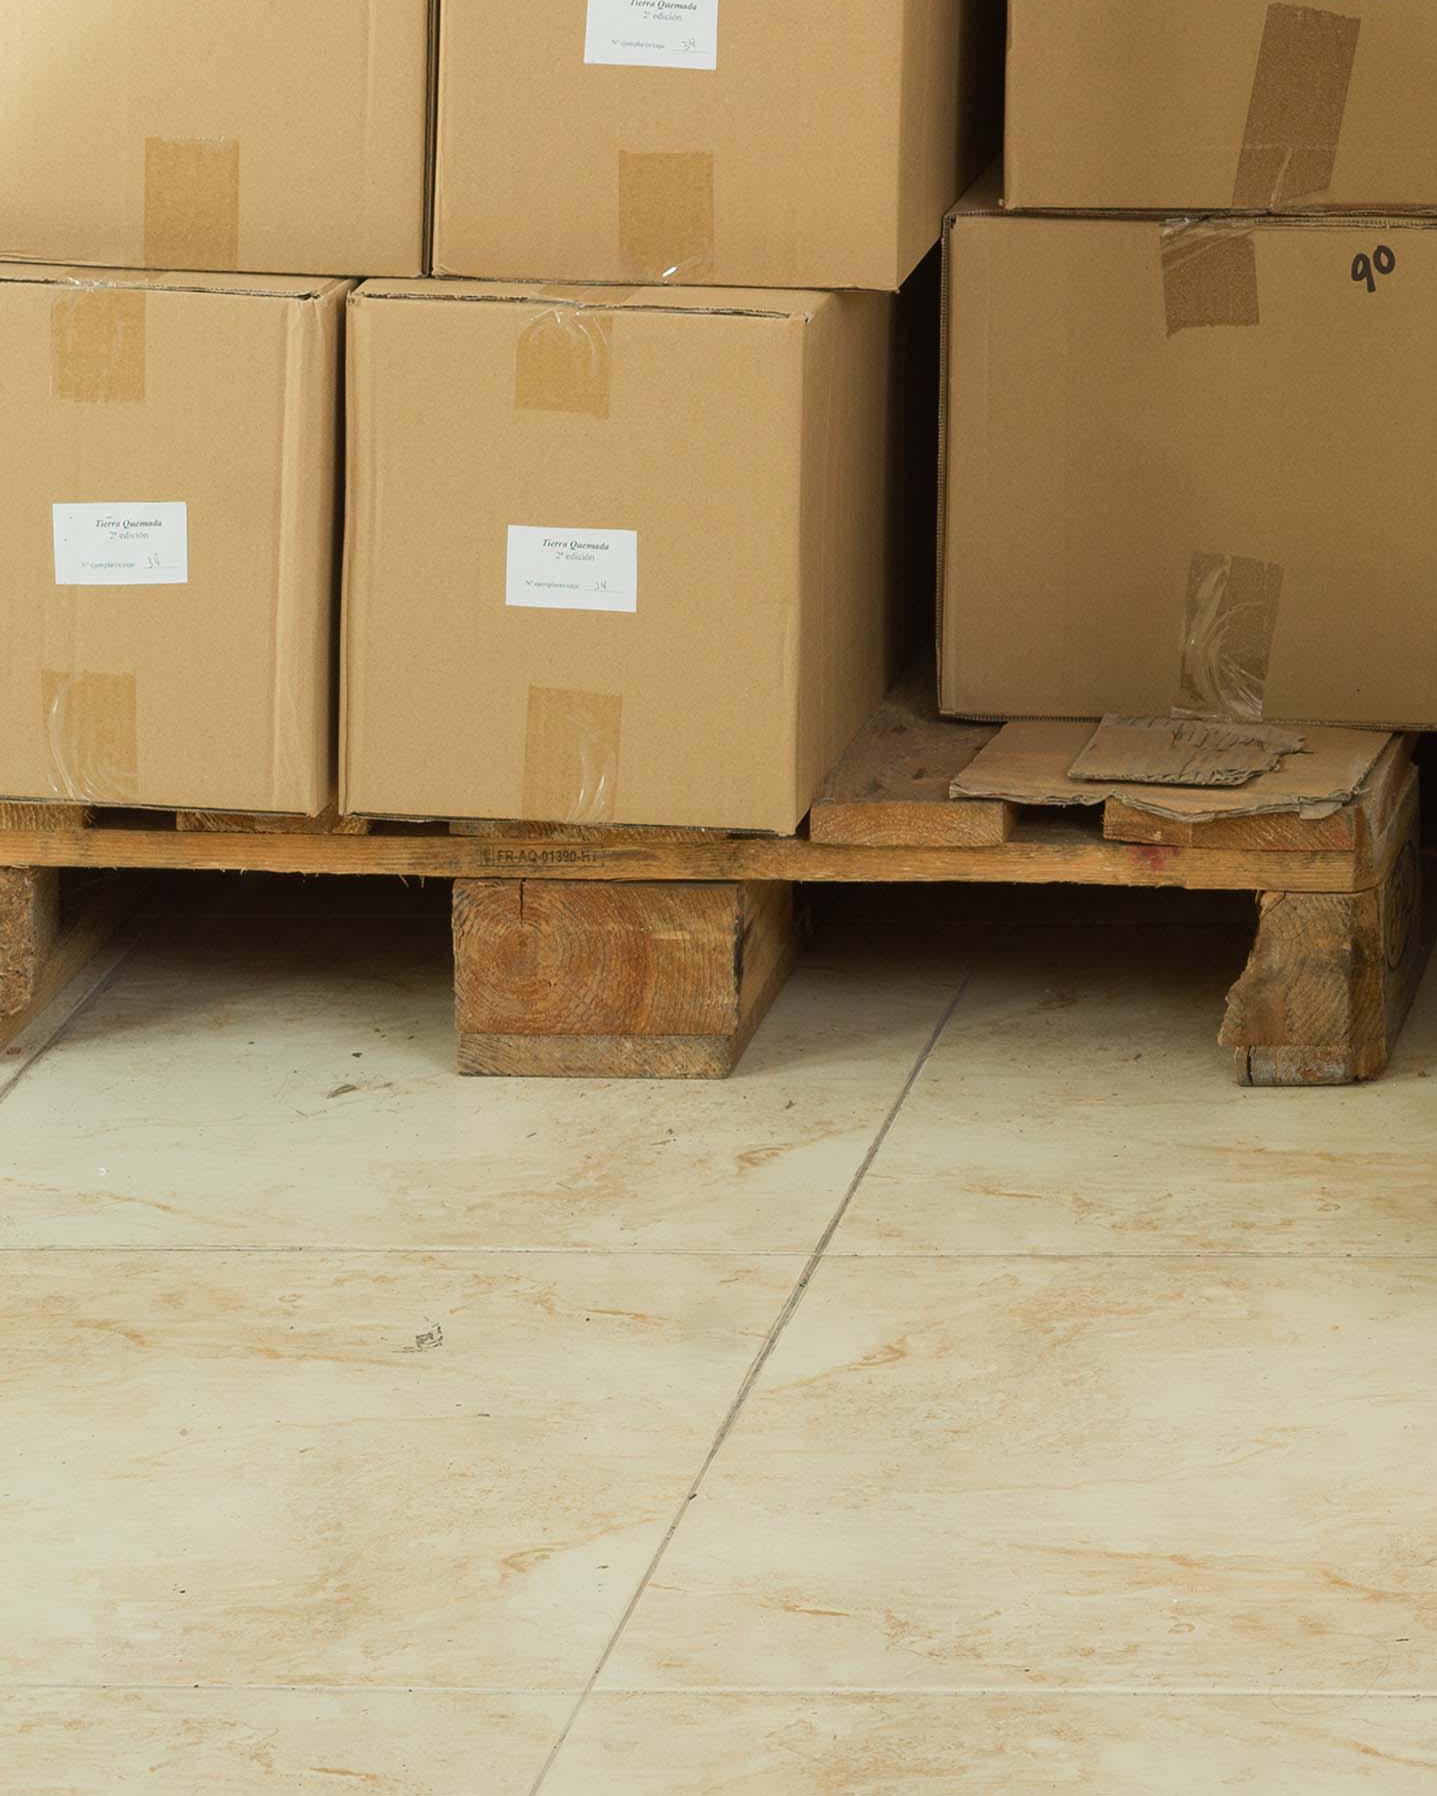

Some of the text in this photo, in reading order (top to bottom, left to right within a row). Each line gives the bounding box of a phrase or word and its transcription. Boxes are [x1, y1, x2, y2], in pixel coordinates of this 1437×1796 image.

[657, 0, 697, 10] Quemada
[1351, 244, 1397, 294] 90
[96, 519, 162, 529] Tierra Quemada
[543, 538, 609, 551] Tierra Quemada
